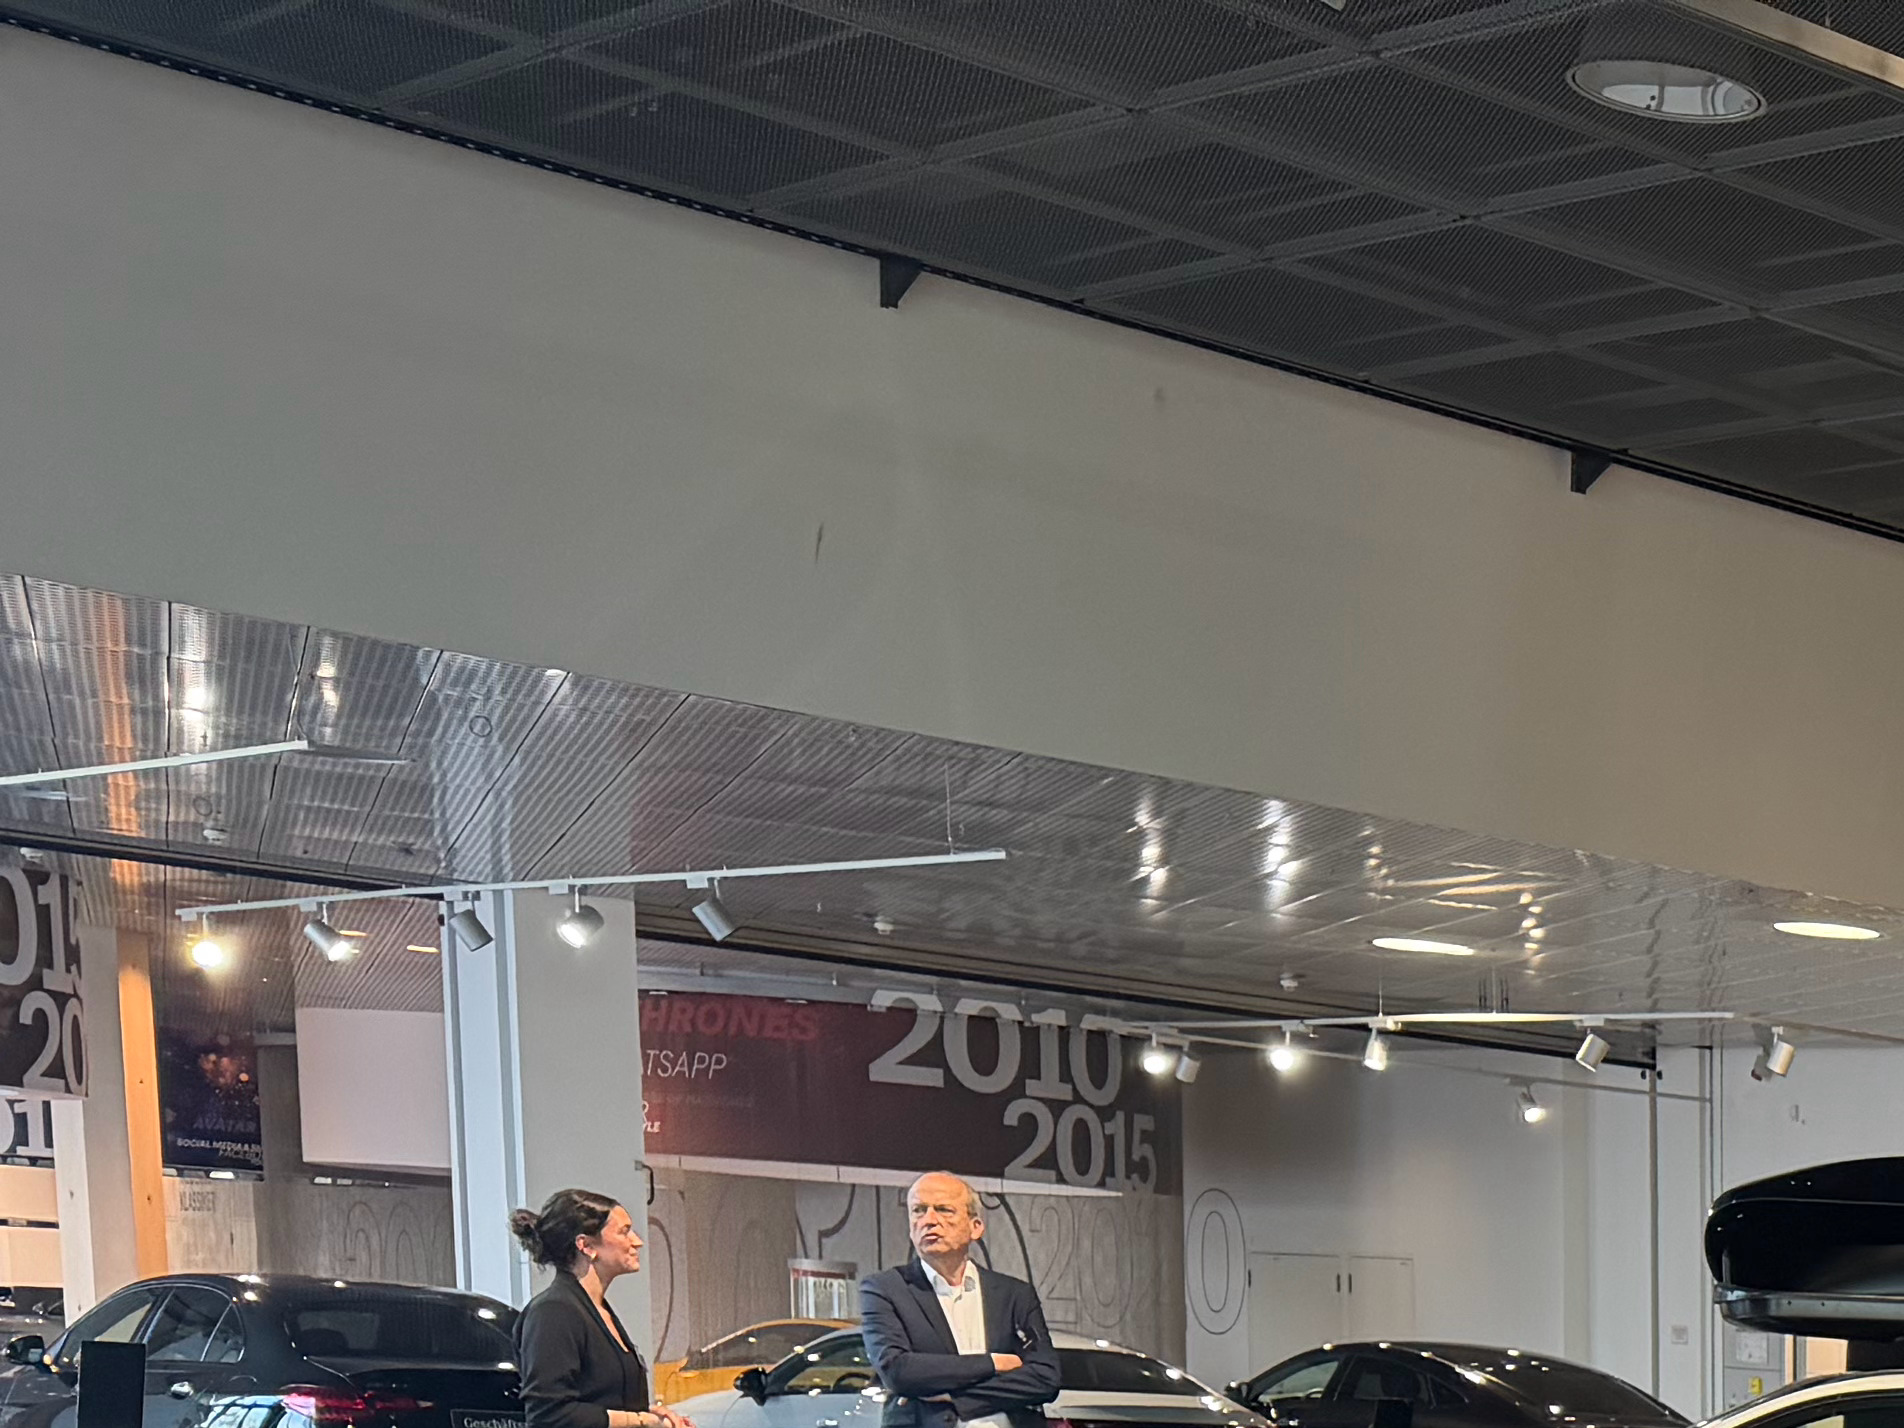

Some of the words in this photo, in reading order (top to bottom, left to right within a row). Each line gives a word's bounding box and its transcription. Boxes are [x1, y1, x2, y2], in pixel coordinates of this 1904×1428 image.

[638, 997, 819, 1040] HRONES
[868, 989, 1122, 1106] 2010
[642, 1049, 727, 1079] TSAPP
[1003, 1100, 1157, 1195] 2015
